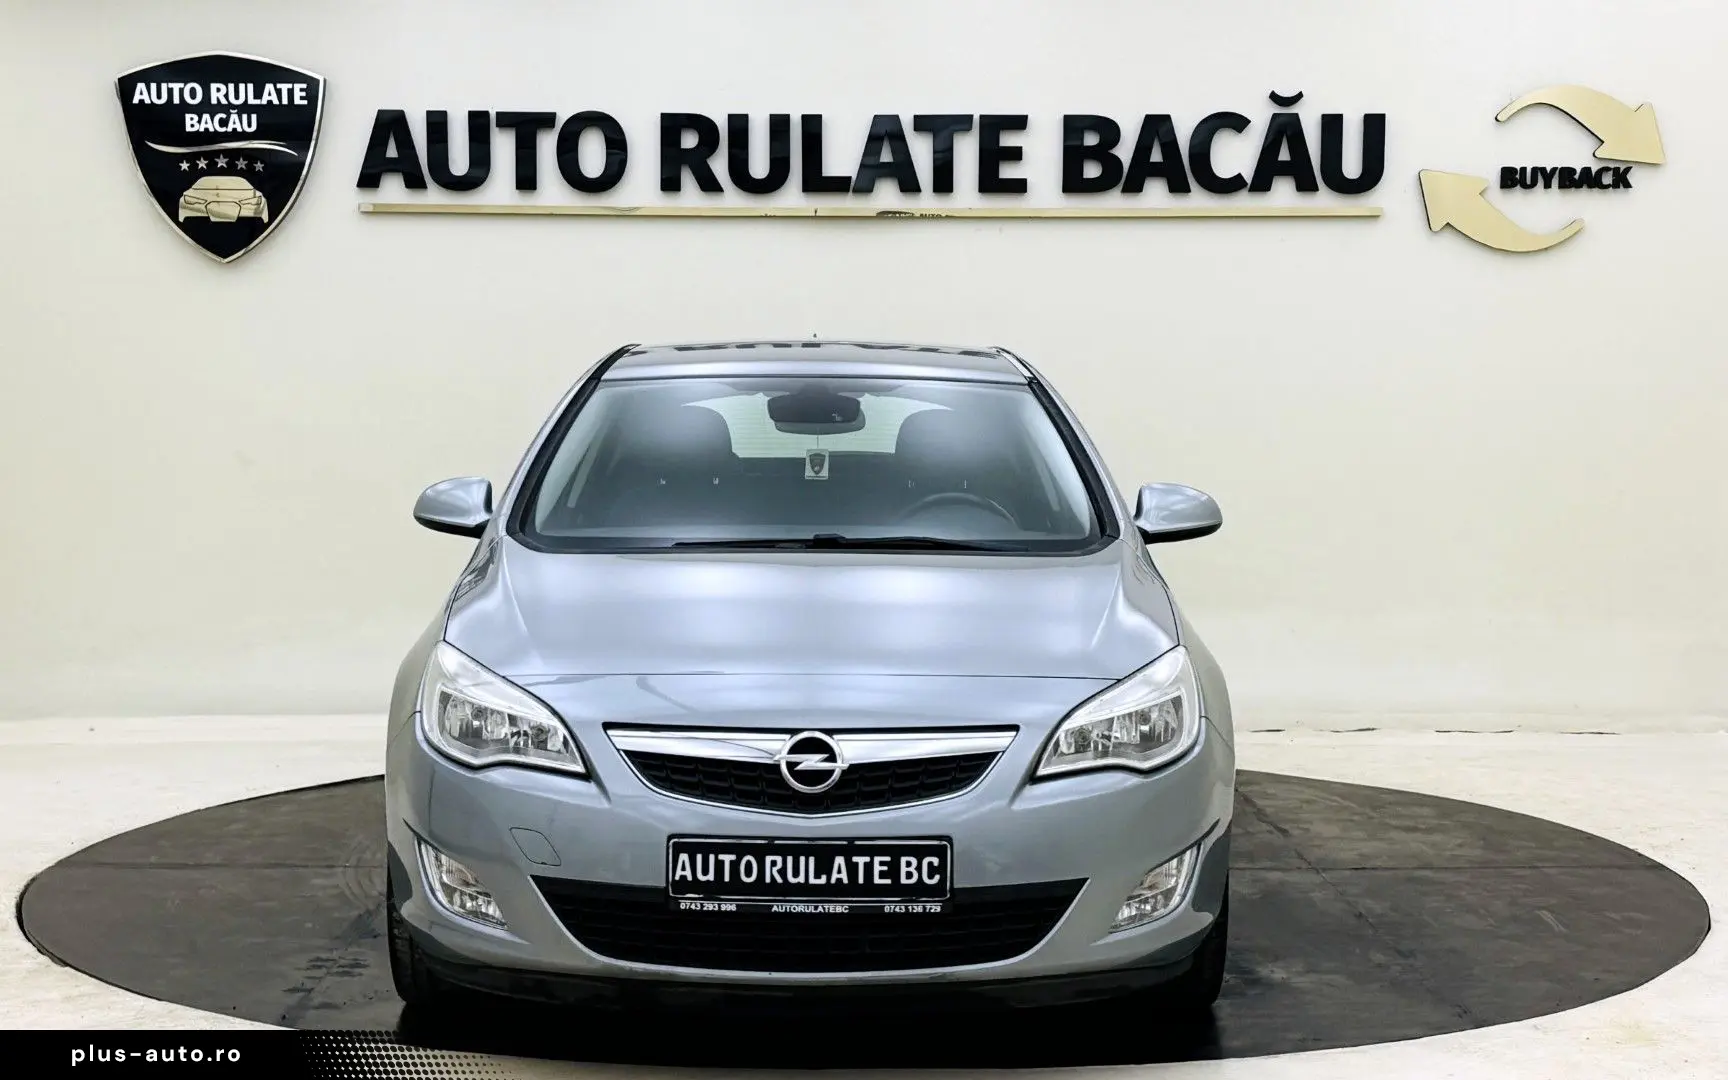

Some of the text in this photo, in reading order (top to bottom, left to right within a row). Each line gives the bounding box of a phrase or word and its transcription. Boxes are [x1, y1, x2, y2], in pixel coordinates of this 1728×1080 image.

[132, 82, 308, 105] AUTO RULATE
[184, 109, 258, 133] BACĂU
[356, 90, 1386, 195] AUTO RULATE BACĂU
[1499, 166, 1633, 189] BUYBACK
[674, 852, 941, 885] AUTO RULATE BC
[679, 902, 701, 910] 0743
[771, 904, 849, 913] AUTORULATEBC
